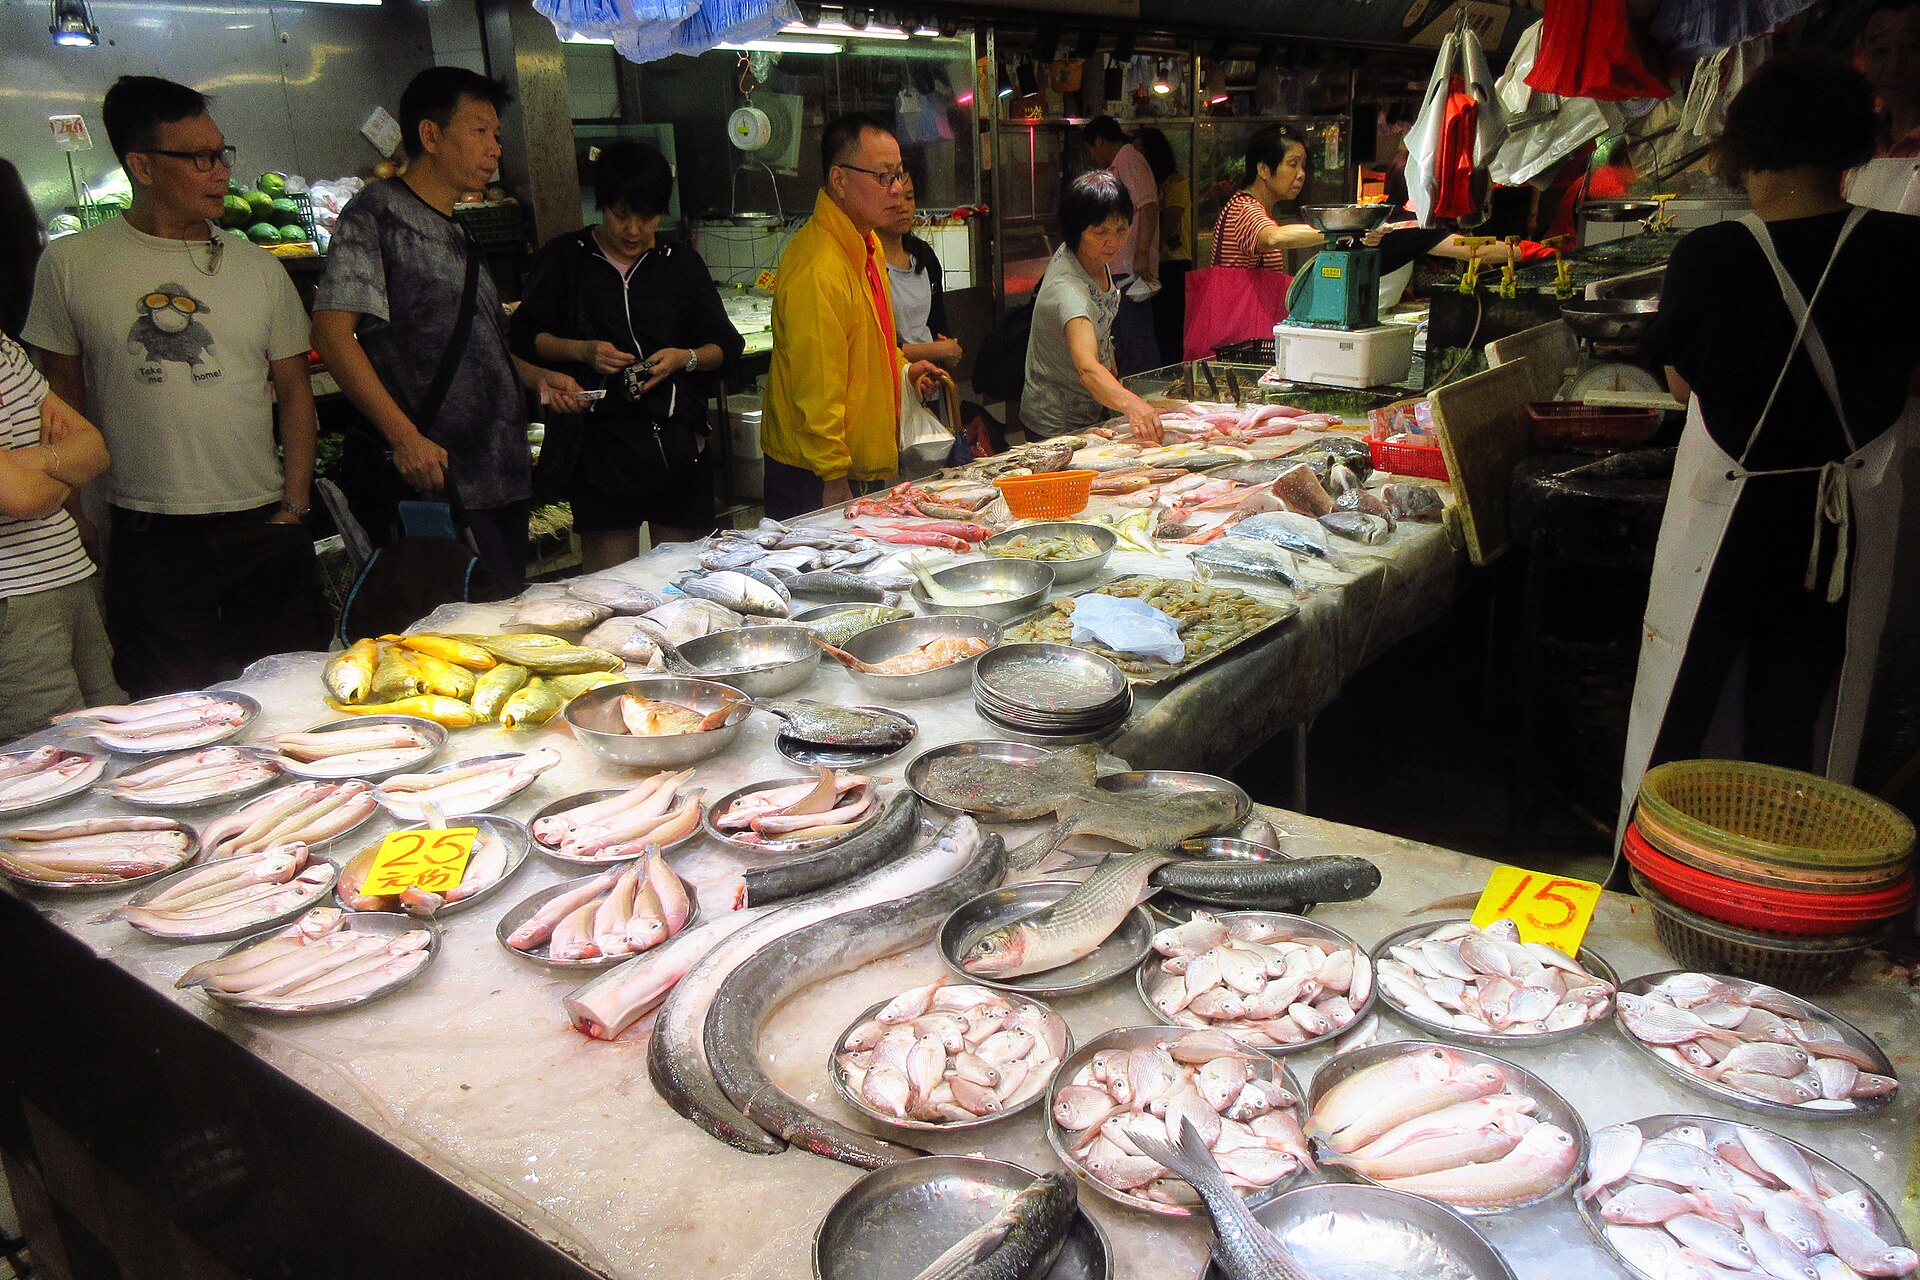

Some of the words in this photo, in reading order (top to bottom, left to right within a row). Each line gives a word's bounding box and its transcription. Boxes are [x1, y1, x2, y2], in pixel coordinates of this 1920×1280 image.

[139, 367, 162, 376] Take
[193, 369, 223, 382] home!
[148, 376, 163, 384] me
[381, 833, 475, 868] 25
[1498, 875, 1595, 930] 15
